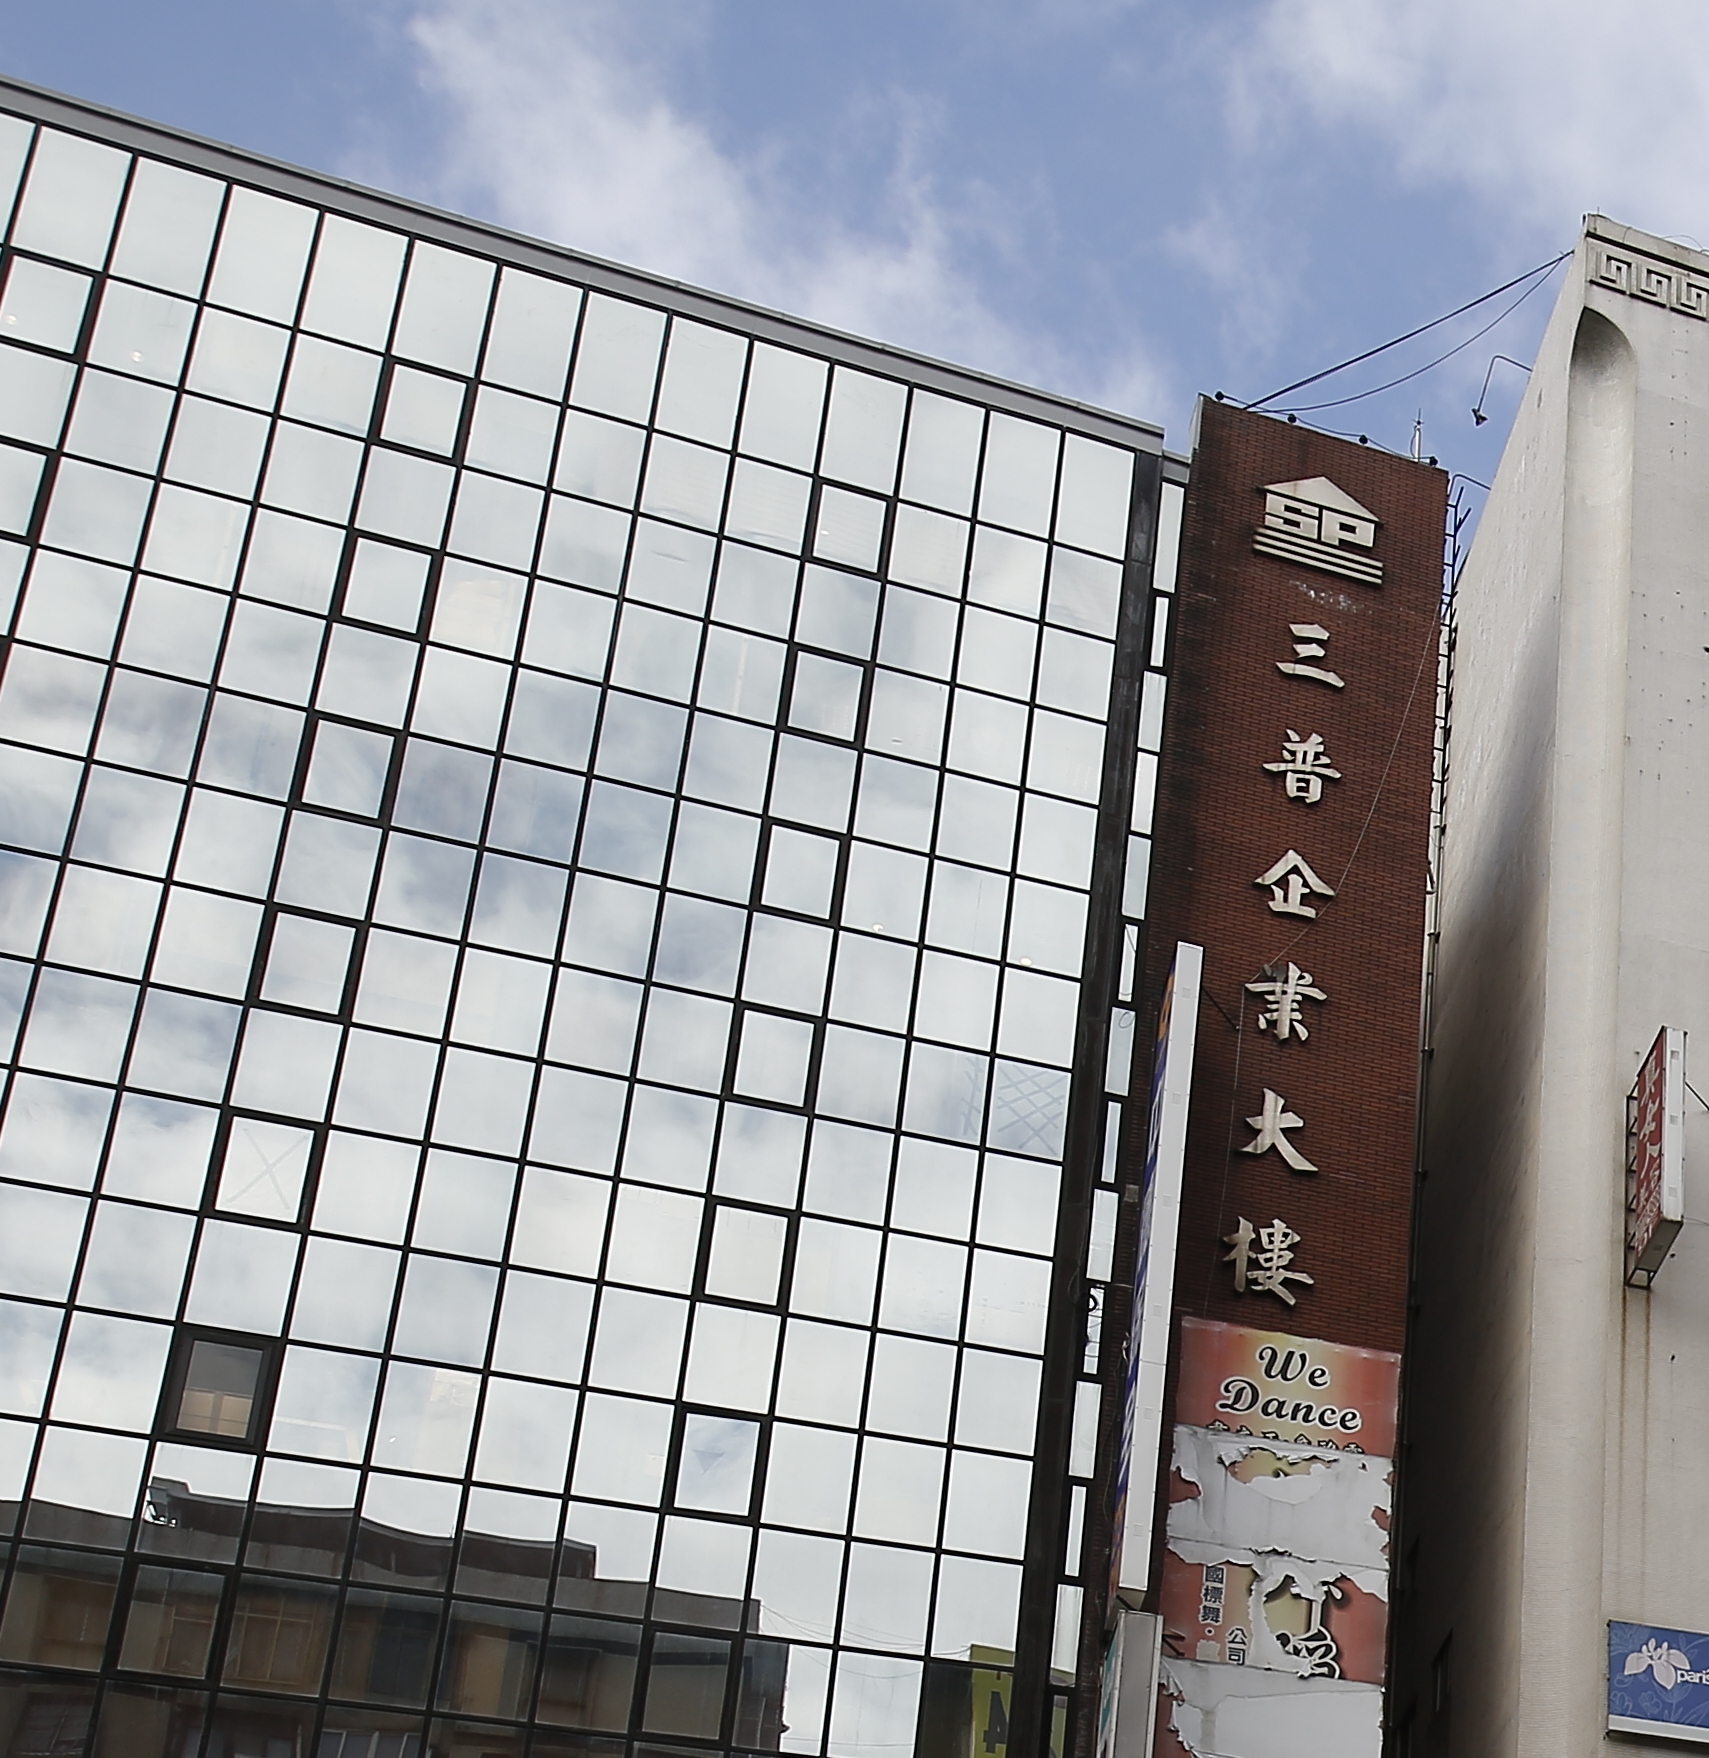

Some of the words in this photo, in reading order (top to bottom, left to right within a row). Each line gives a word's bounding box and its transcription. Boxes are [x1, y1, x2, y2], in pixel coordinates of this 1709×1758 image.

[1221, 620, 1346, 1307] 三普企業大樓
[1258, 1346, 1328, 1387] We
[1219, 1379, 1360, 1431] Dance
[1227, 1628, 1247, 1665] 公司
